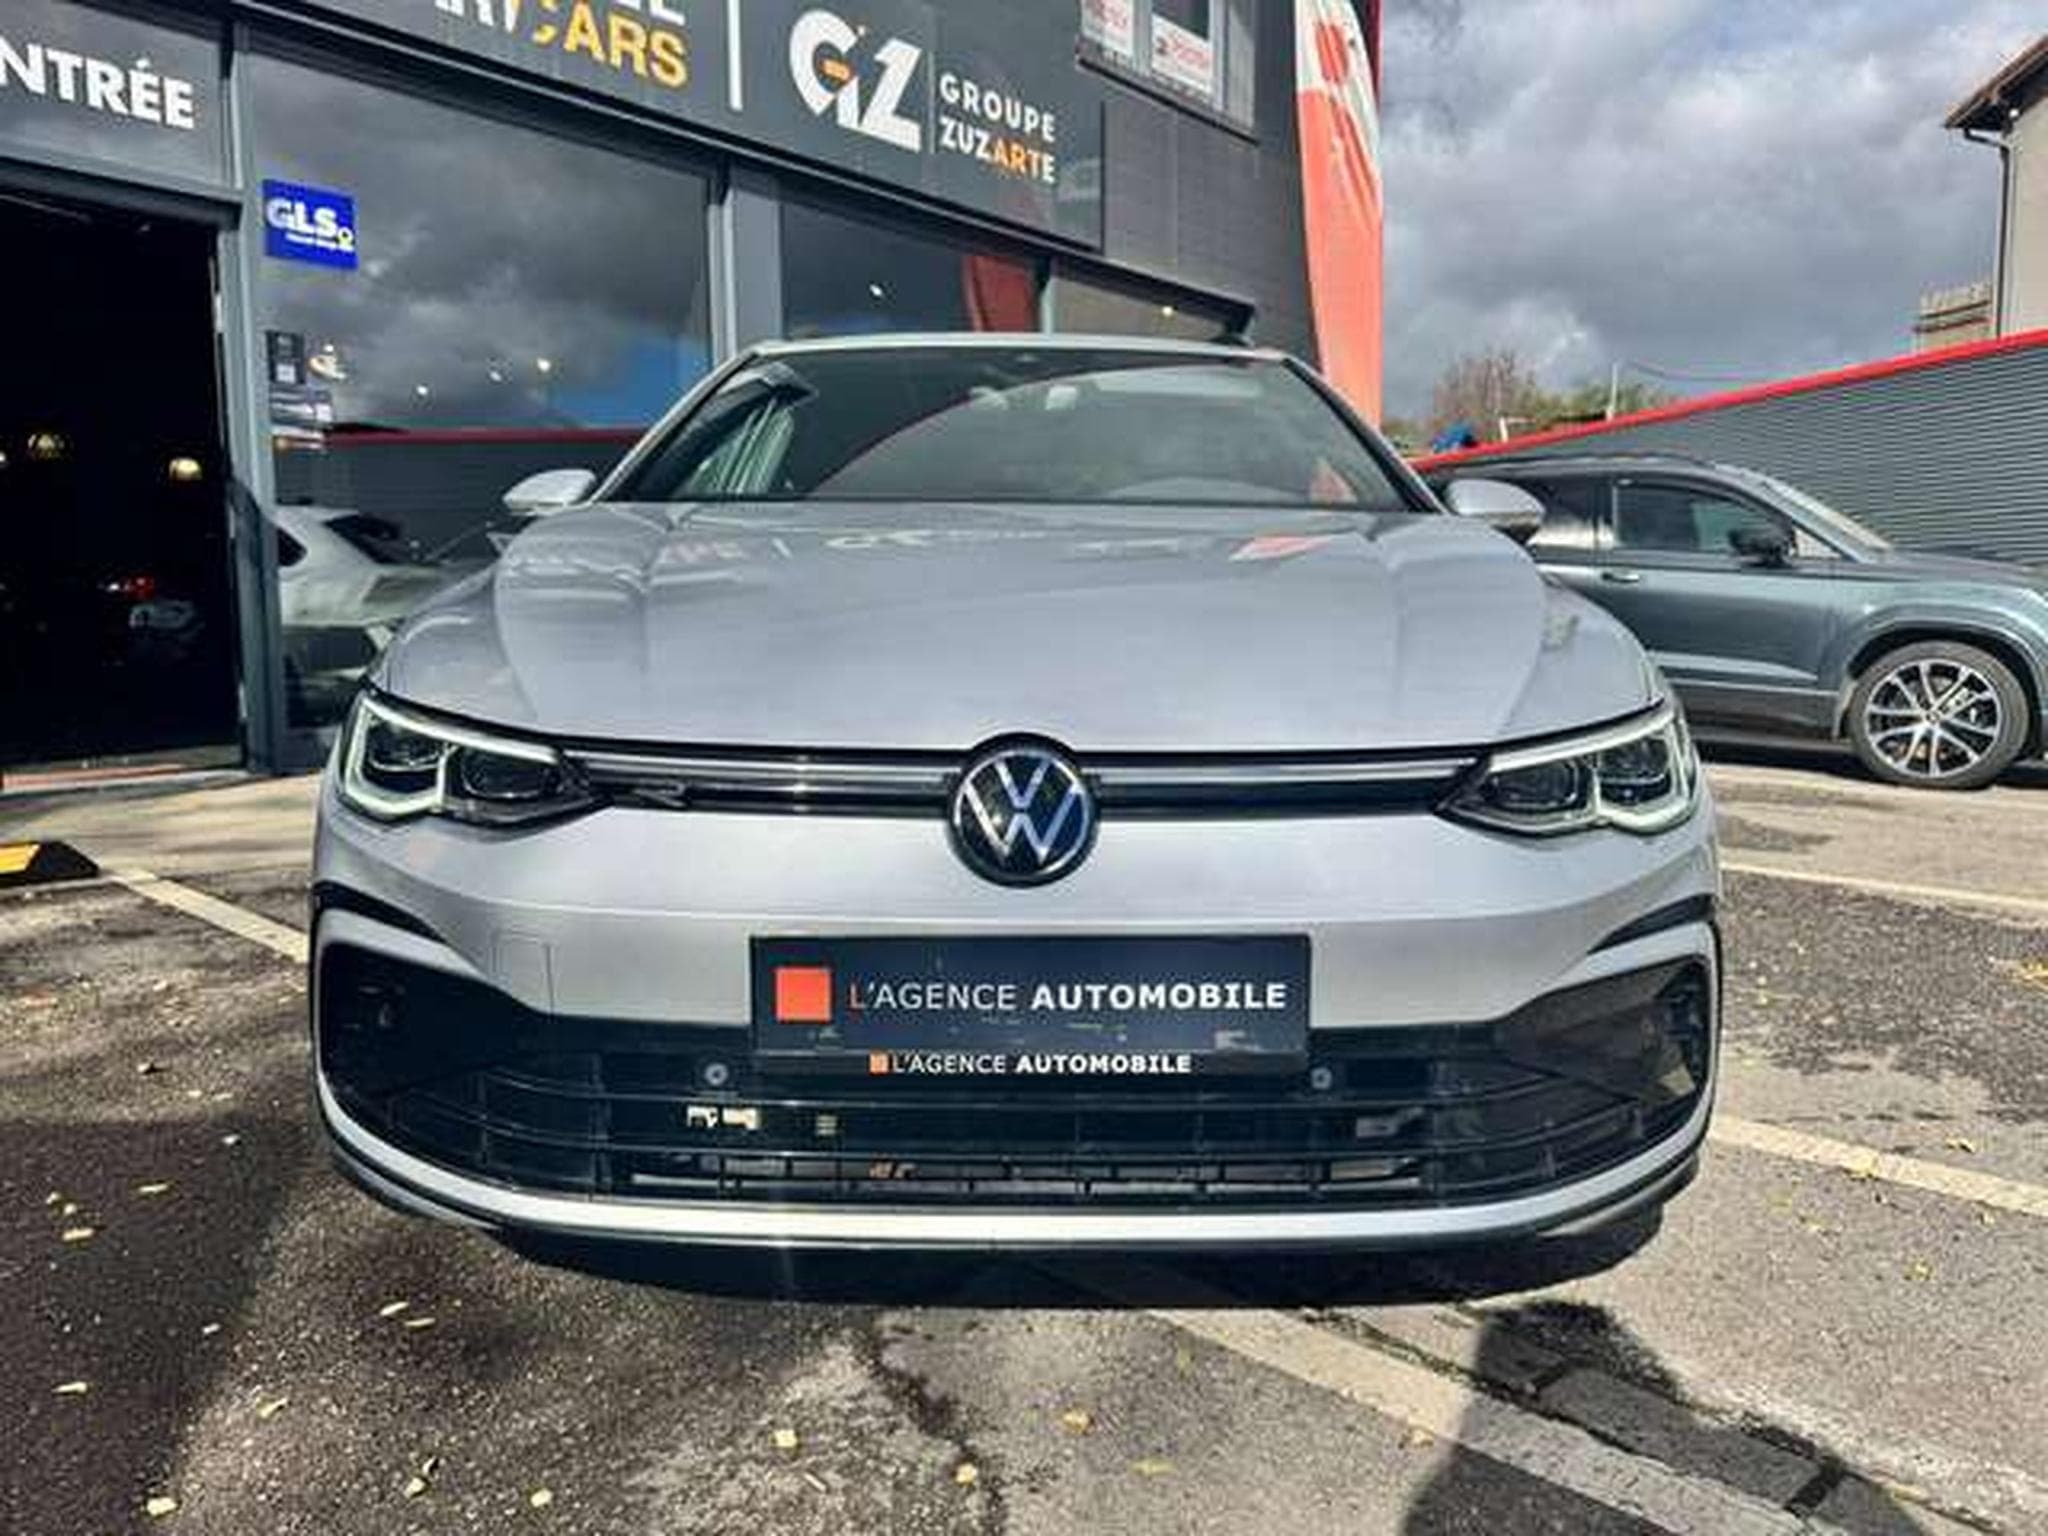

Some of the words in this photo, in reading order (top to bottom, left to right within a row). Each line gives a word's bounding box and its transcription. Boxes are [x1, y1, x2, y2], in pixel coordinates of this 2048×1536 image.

[939, 73, 1056, 143] GROUPE
[939, 117, 1056, 183] ZUZARTE
[266, 197, 338, 238] GLS
[849, 981, 1018, 1010] L'AGENCE
[1030, 982, 1287, 1010] AUTOMOBILE
[892, 1053, 1007, 1074] L'AGENCE
[1015, 1054, 1192, 1074] AUTOMOBILE
